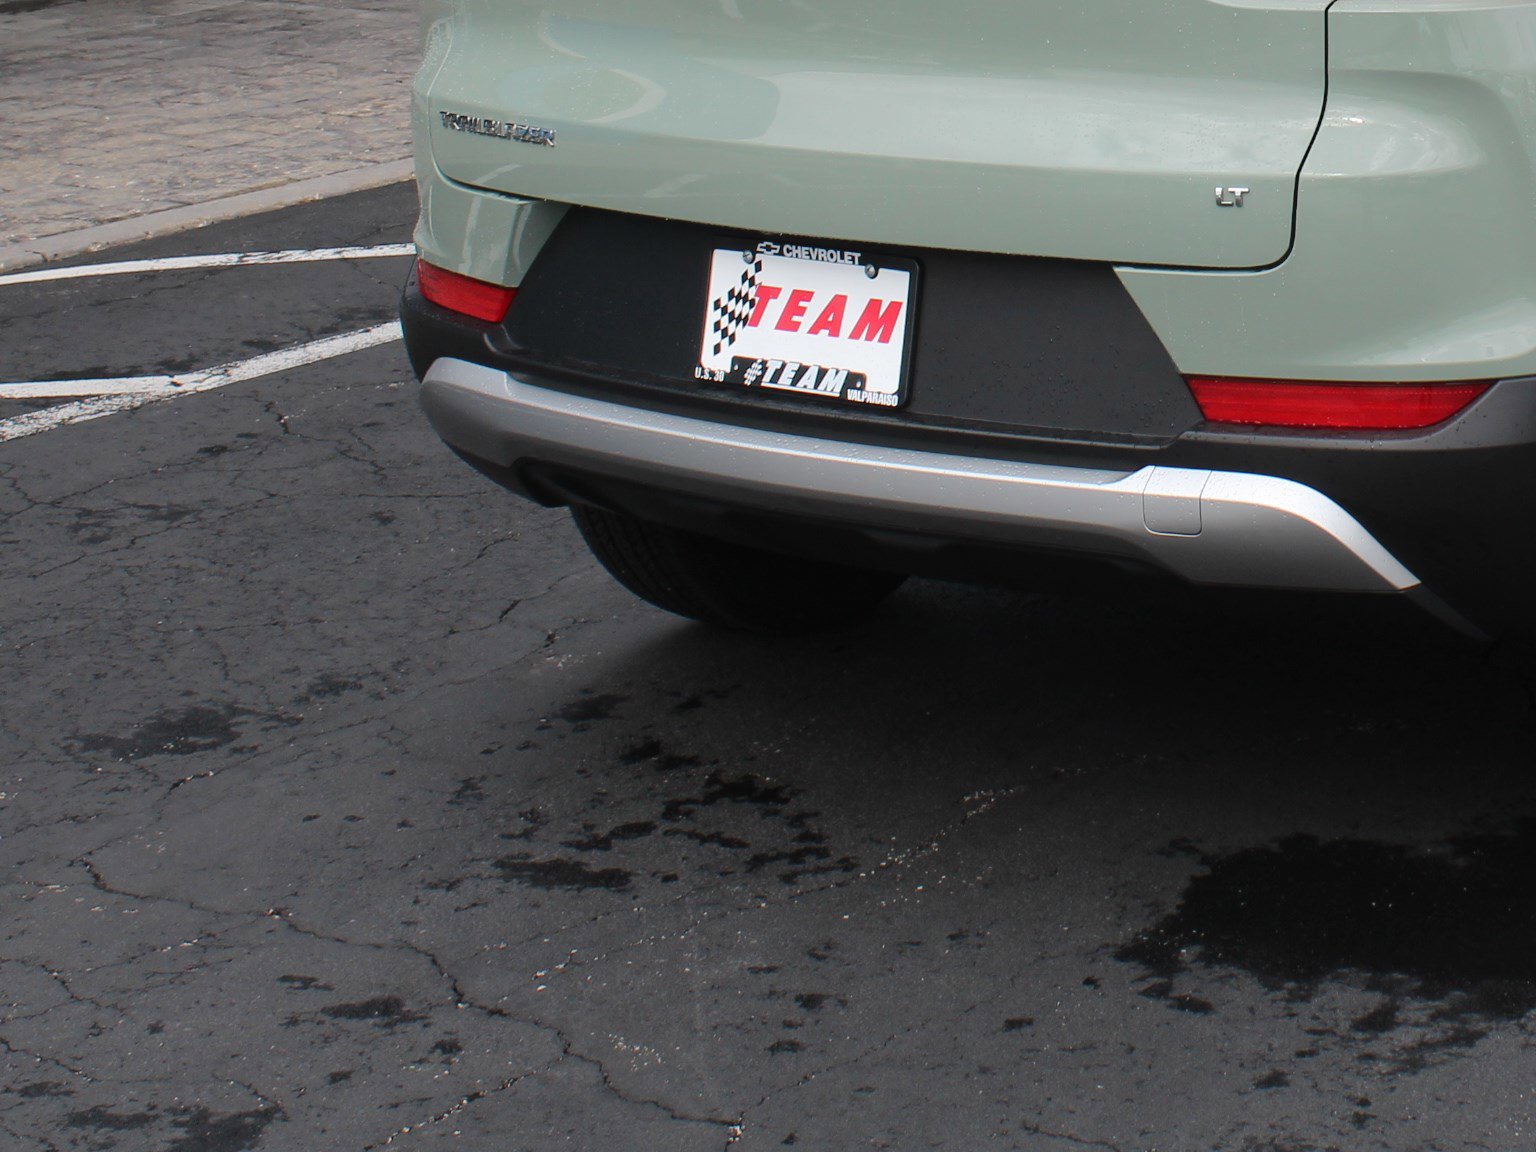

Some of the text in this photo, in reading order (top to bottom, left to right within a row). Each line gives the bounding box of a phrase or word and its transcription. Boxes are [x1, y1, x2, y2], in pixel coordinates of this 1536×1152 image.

[1215, 187, 1250, 208] LT
[783, 244, 862, 265] CHEVROLET
[747, 284, 903, 344] TEAM
[761, 359, 849, 394] TEAM
[847, 388, 899, 408] VALPARAISO
